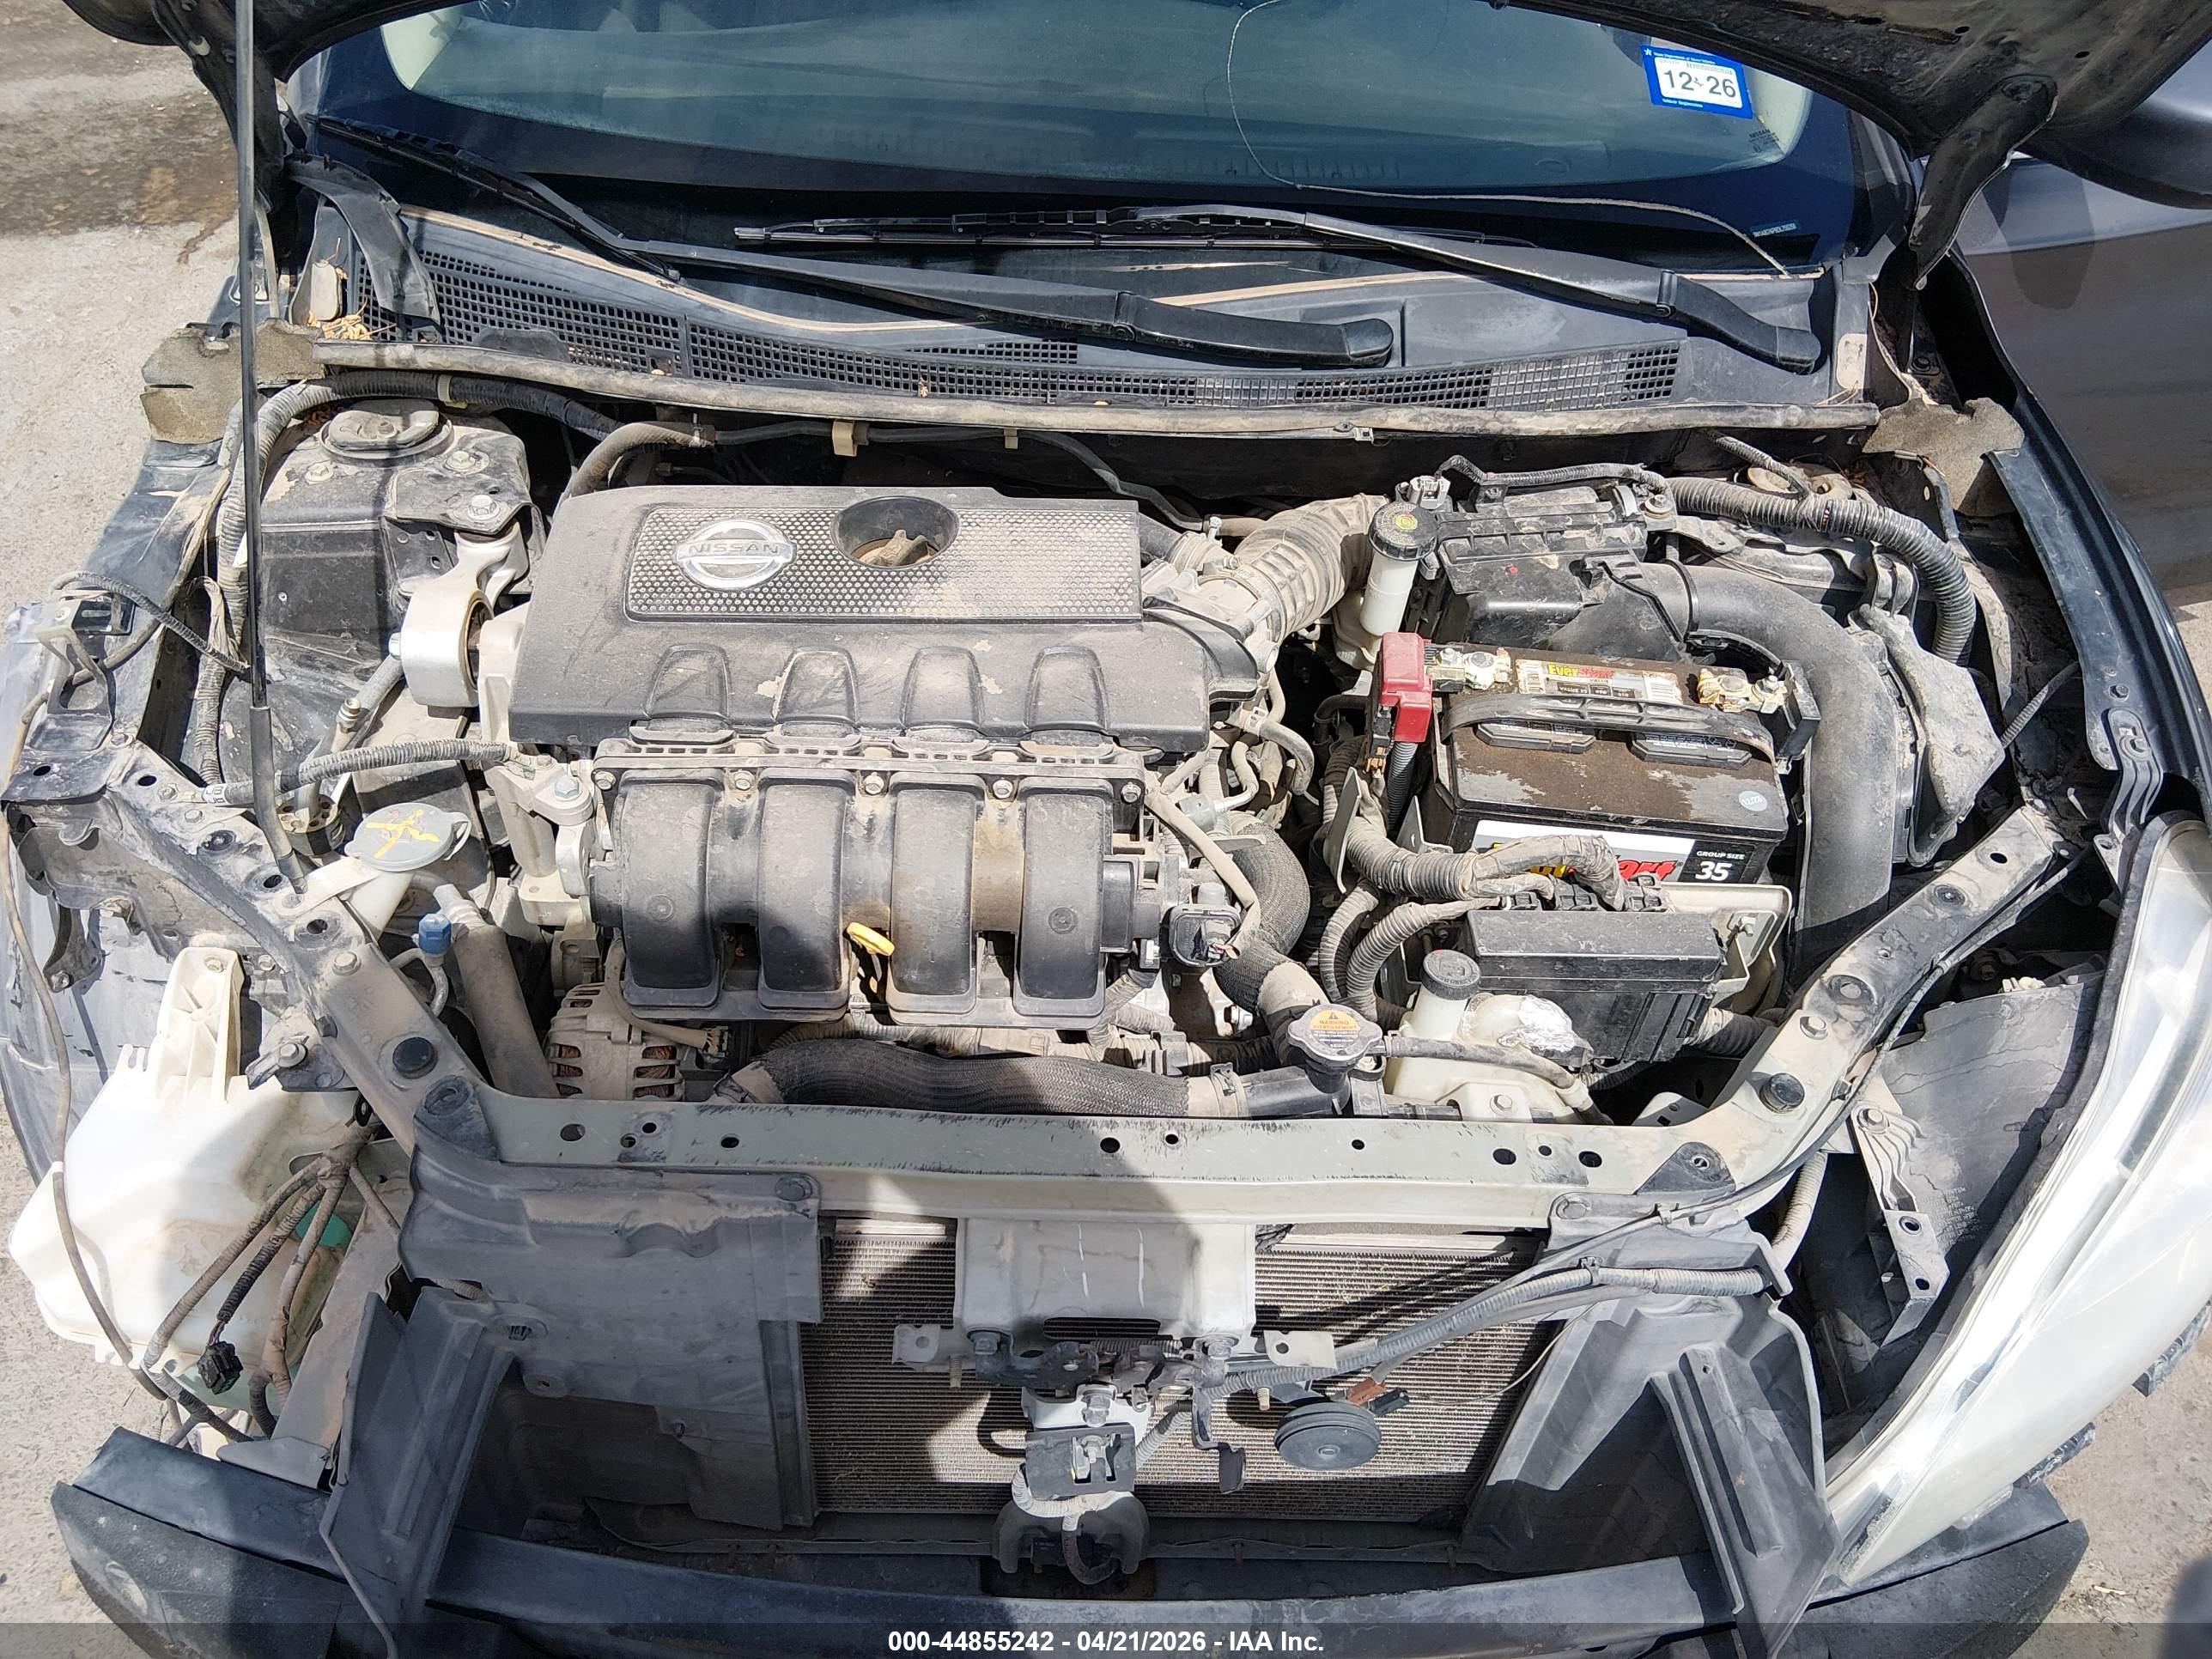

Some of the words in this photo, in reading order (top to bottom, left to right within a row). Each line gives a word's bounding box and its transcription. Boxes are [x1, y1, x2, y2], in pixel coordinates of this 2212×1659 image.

[1663, 69, 1695, 91] 12
[1706, 76, 1736, 98] 26
[688, 543, 779, 555] NISSAN
[1695, 860, 1732, 881] 35
